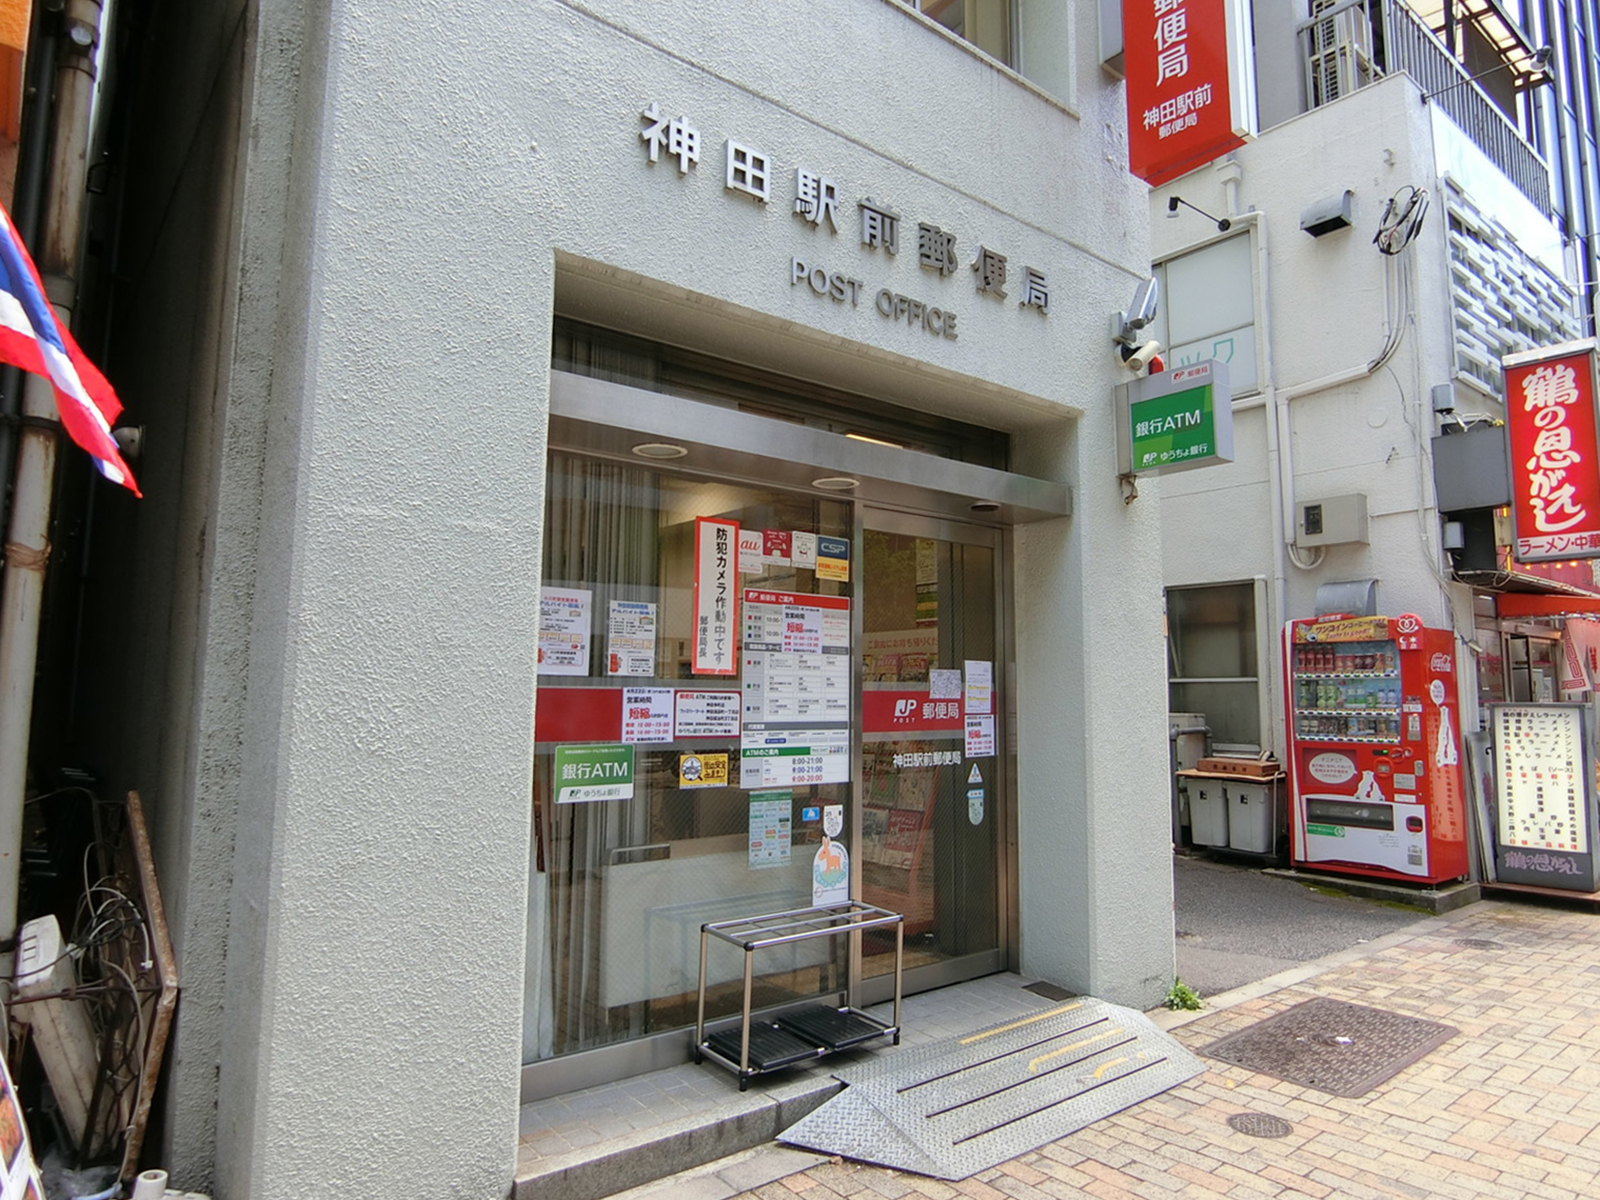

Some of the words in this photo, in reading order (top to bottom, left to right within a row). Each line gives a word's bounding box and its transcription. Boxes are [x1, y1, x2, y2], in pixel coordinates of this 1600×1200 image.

[1143, 83, 1212, 131] 神田駅前
[1158, 112, 1198, 140] 郵便局
[640, 102, 1051, 315] 神田駅前郵便局
[791, 256, 862, 307] POST
[876, 287, 958, 340] OFFICE
[1135, 409, 1201, 438] 銀行ATM
[1160, 443, 1208, 462] ゆうちょ銀行
[1521, 363, 1587, 533] 鶴の恩がえし
[740, 539, 761, 551] au
[820, 542, 846, 555] CSP
[713, 527, 728, 666] 防犯カメラ作動中です
[698, 616, 709, 658] 郵便局長
[629, 707, 651, 719] 短縮
[894, 699, 917, 717] JP
[922, 701, 960, 720] 郵便局
[562, 761, 628, 780] 銀行ATM
[892, 750, 962, 768] 神田駅前郵便局
[584, 787, 621, 797] ゆうちょ銀行
